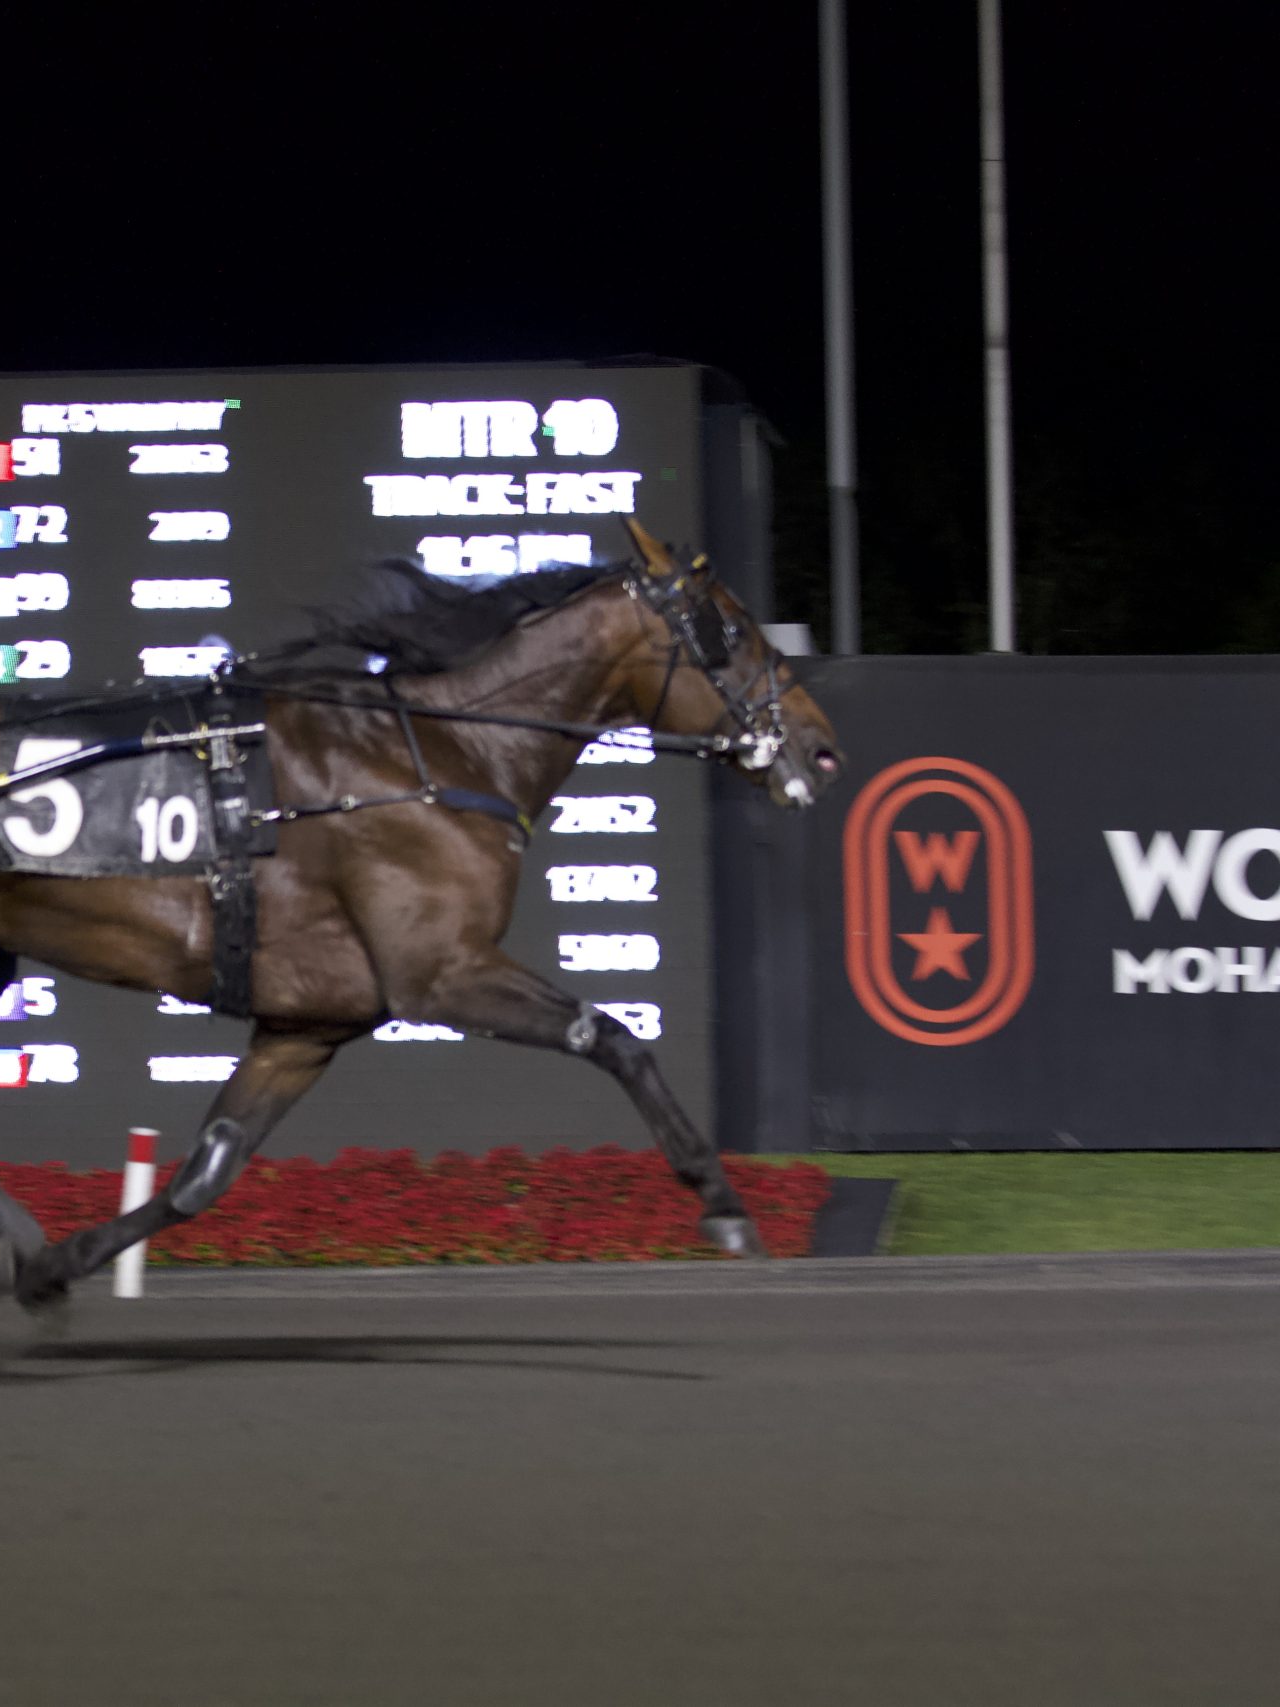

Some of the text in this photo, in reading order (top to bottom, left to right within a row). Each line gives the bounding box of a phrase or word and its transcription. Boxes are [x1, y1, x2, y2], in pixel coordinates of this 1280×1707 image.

[3, 738, 84, 857] 5
[135, 795, 198, 863] 10
[893, 830, 981, 894] W
[1102, 827, 1280, 922] WO
